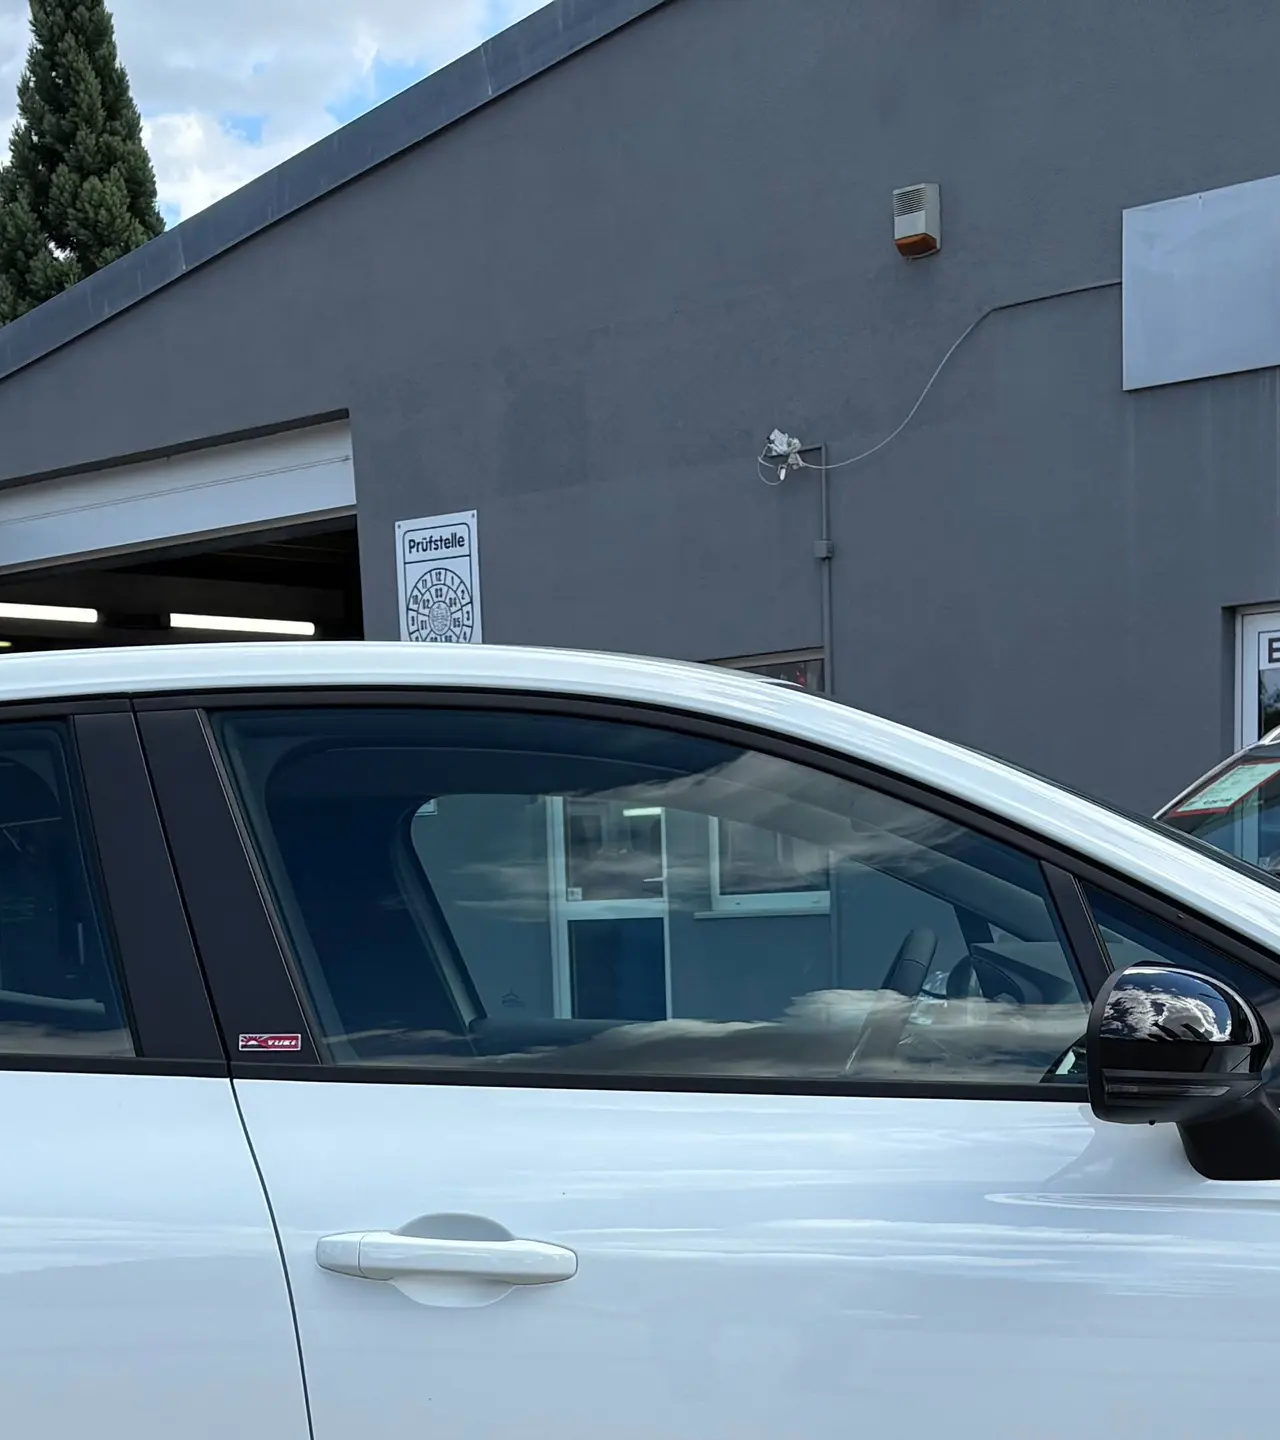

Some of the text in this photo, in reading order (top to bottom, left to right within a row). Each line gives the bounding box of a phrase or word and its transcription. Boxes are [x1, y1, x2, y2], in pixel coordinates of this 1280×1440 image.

[408, 532, 466, 554] Prüfstelle
[434, 570, 443, 583] 12
[434, 587, 443, 599] 03
[460, 589, 466, 601] 2
[422, 598, 431, 610] 02
[466, 610, 471, 622] 3
